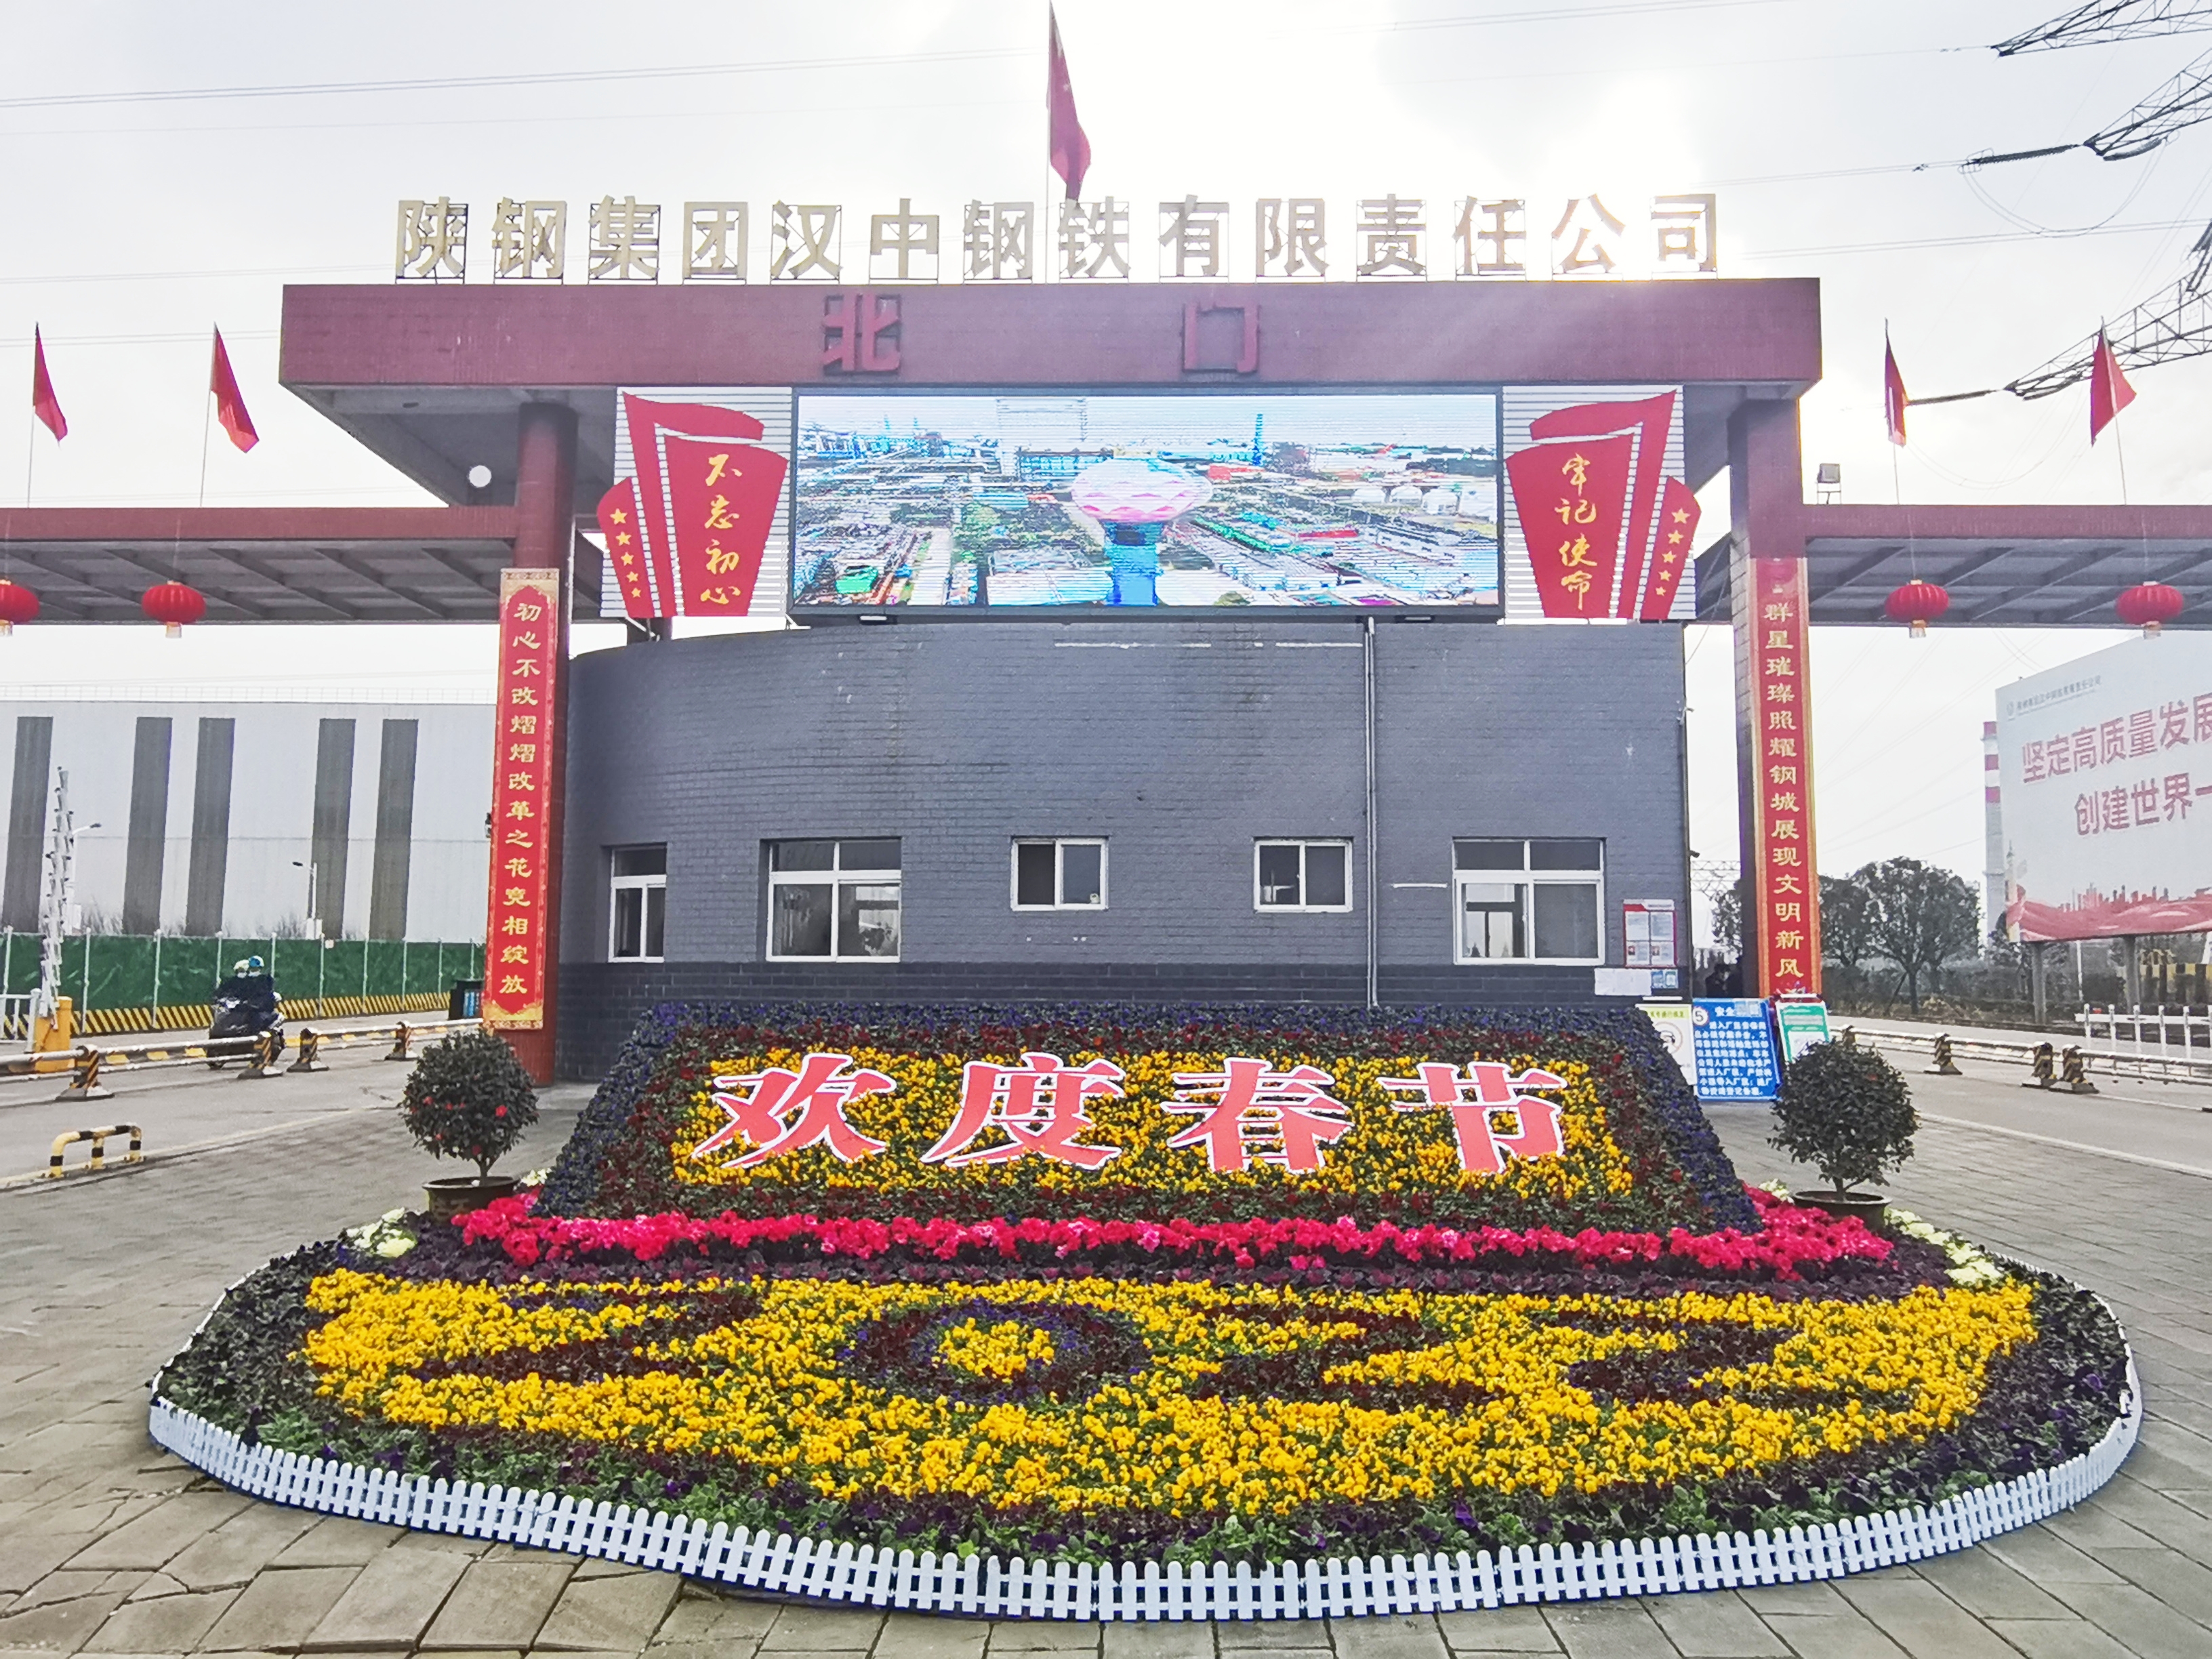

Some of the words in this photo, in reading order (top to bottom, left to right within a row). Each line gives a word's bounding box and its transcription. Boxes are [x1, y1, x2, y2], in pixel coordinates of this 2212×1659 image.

[397, 194, 1716, 279] 陕钢集团汉中钢铁有限责任公司
[821, 292, 1258, 373] 北门
[700, 453, 743, 605] 不忘初心
[1555, 453, 1597, 611] 牢记使命
[499, 602, 542, 994] 初心不改熠熠改革之花竞相绽放
[1763, 602, 1804, 978] 群星璀璨照耀钢城展现文明新风
[2022, 692, 2212, 783] 坚定高质量发展
[2074, 773, 2212, 836] 创建世界一
[694, 1051, 1568, 1176] 欢度春节
